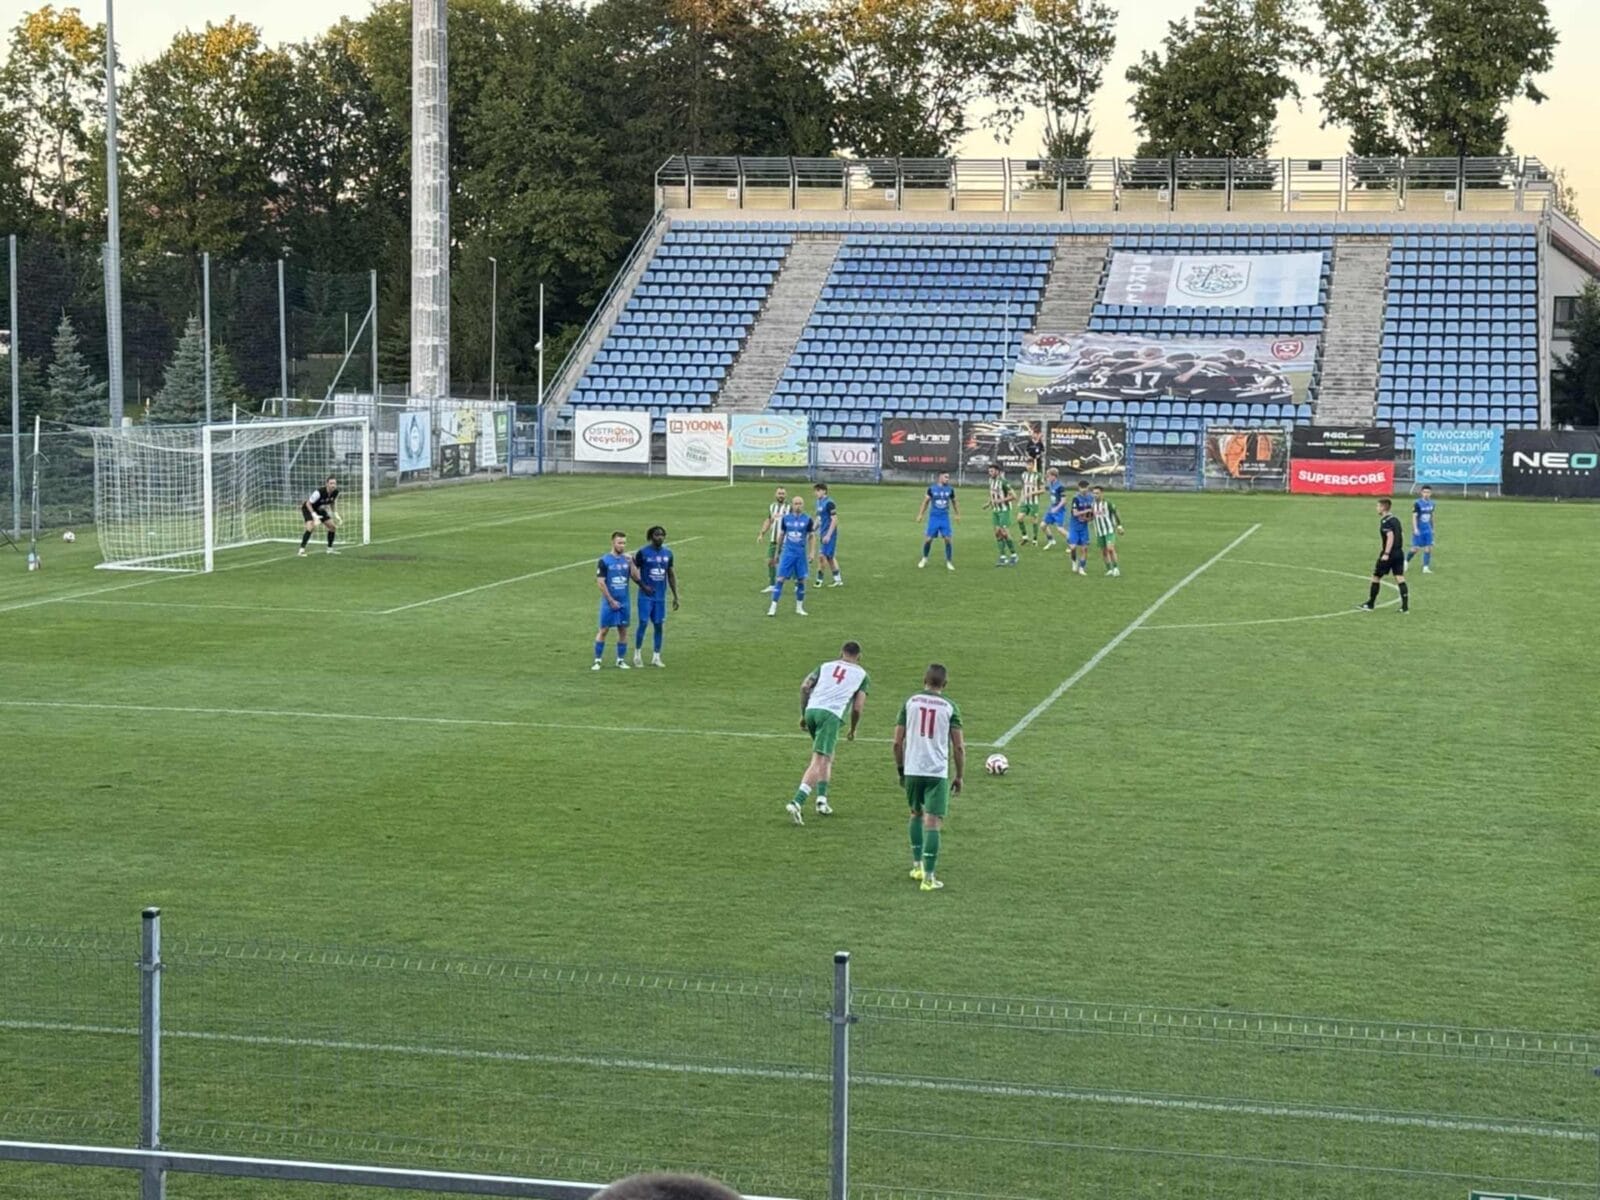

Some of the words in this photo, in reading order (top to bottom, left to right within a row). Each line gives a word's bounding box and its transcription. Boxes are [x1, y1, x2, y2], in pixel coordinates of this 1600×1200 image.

[684, 420, 724, 431] YOONA
[1422, 430, 1494, 439] nowoczesne
[1422, 441, 1490, 454] rozwiązania
[1512, 451, 1598, 469] NEO
[1298, 470, 1386, 485] SUPERSCORE
[832, 665, 847, 685] 4
[919, 706, 937, 739] 11
